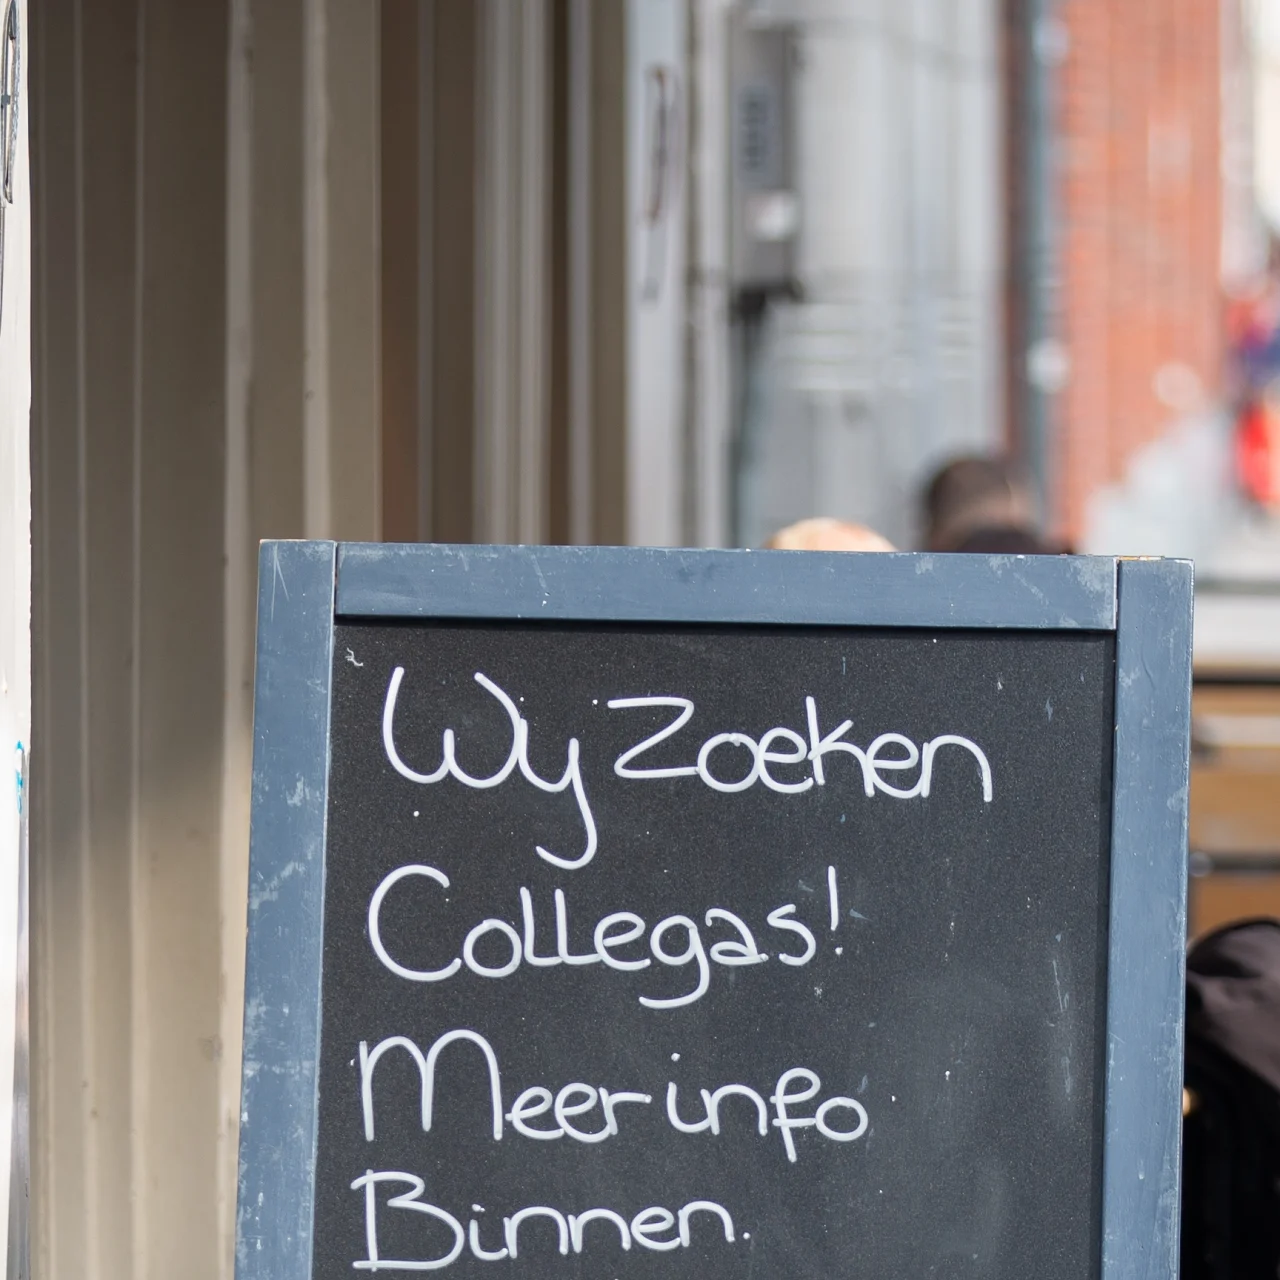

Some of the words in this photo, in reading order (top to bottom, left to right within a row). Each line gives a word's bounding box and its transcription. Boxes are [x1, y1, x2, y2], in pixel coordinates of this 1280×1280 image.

[369, 865, 843, 1009] Collegas!
[360, 1030, 652, 1143] Meer
[667, 1053, 868, 1162] info
[351, 1169, 751, 1272] Binnen.
